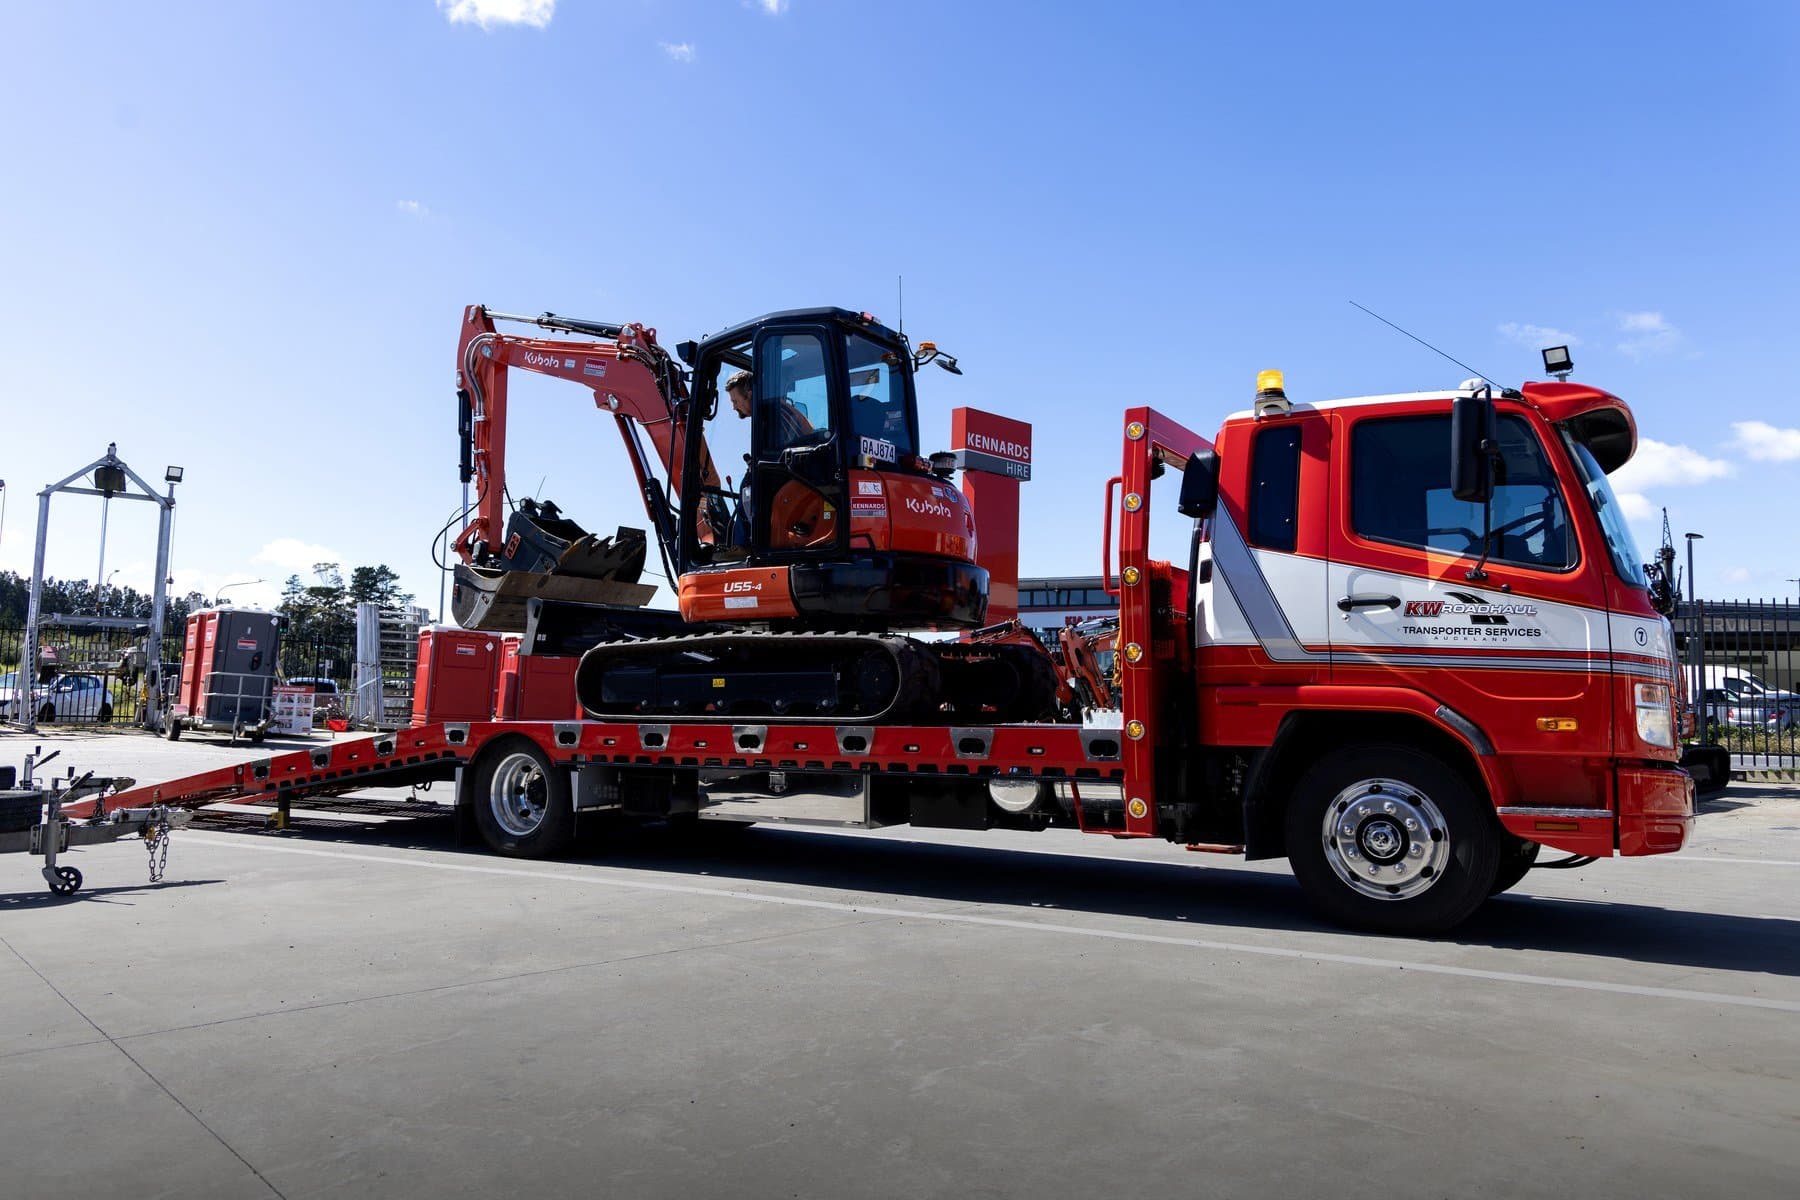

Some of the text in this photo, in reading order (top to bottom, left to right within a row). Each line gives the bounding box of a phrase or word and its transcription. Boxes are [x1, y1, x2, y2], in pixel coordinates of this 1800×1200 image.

[524, 351, 560, 369] Kubota
[862, 439, 895, 460] QAJ874
[967, 432, 1030, 460] KENNARDS
[1006, 462, 1030, 478] HIRE
[905, 498, 952, 518] Kubota
[1403, 626, 1542, 637] TRANSPORTER SERVICES
[1693, 618, 1773, 632] ERVICE
